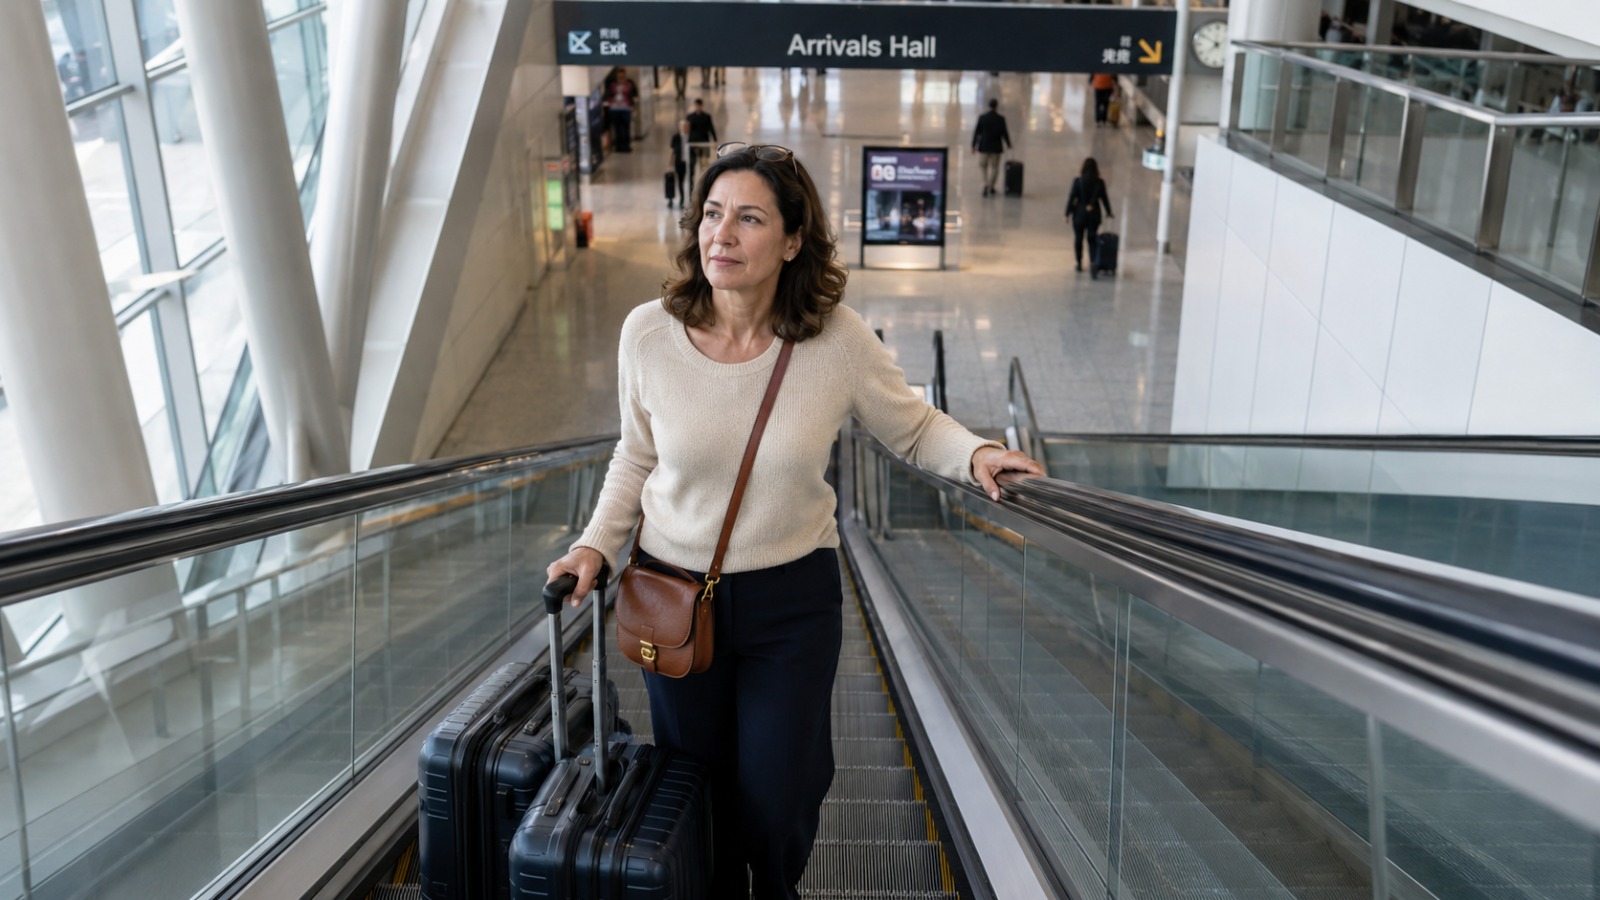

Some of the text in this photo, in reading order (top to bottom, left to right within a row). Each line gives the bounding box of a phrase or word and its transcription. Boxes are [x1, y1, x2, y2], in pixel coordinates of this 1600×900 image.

[600, 41, 627, 55] Exit
[787, 33, 937, 59] Arrivals Hall
